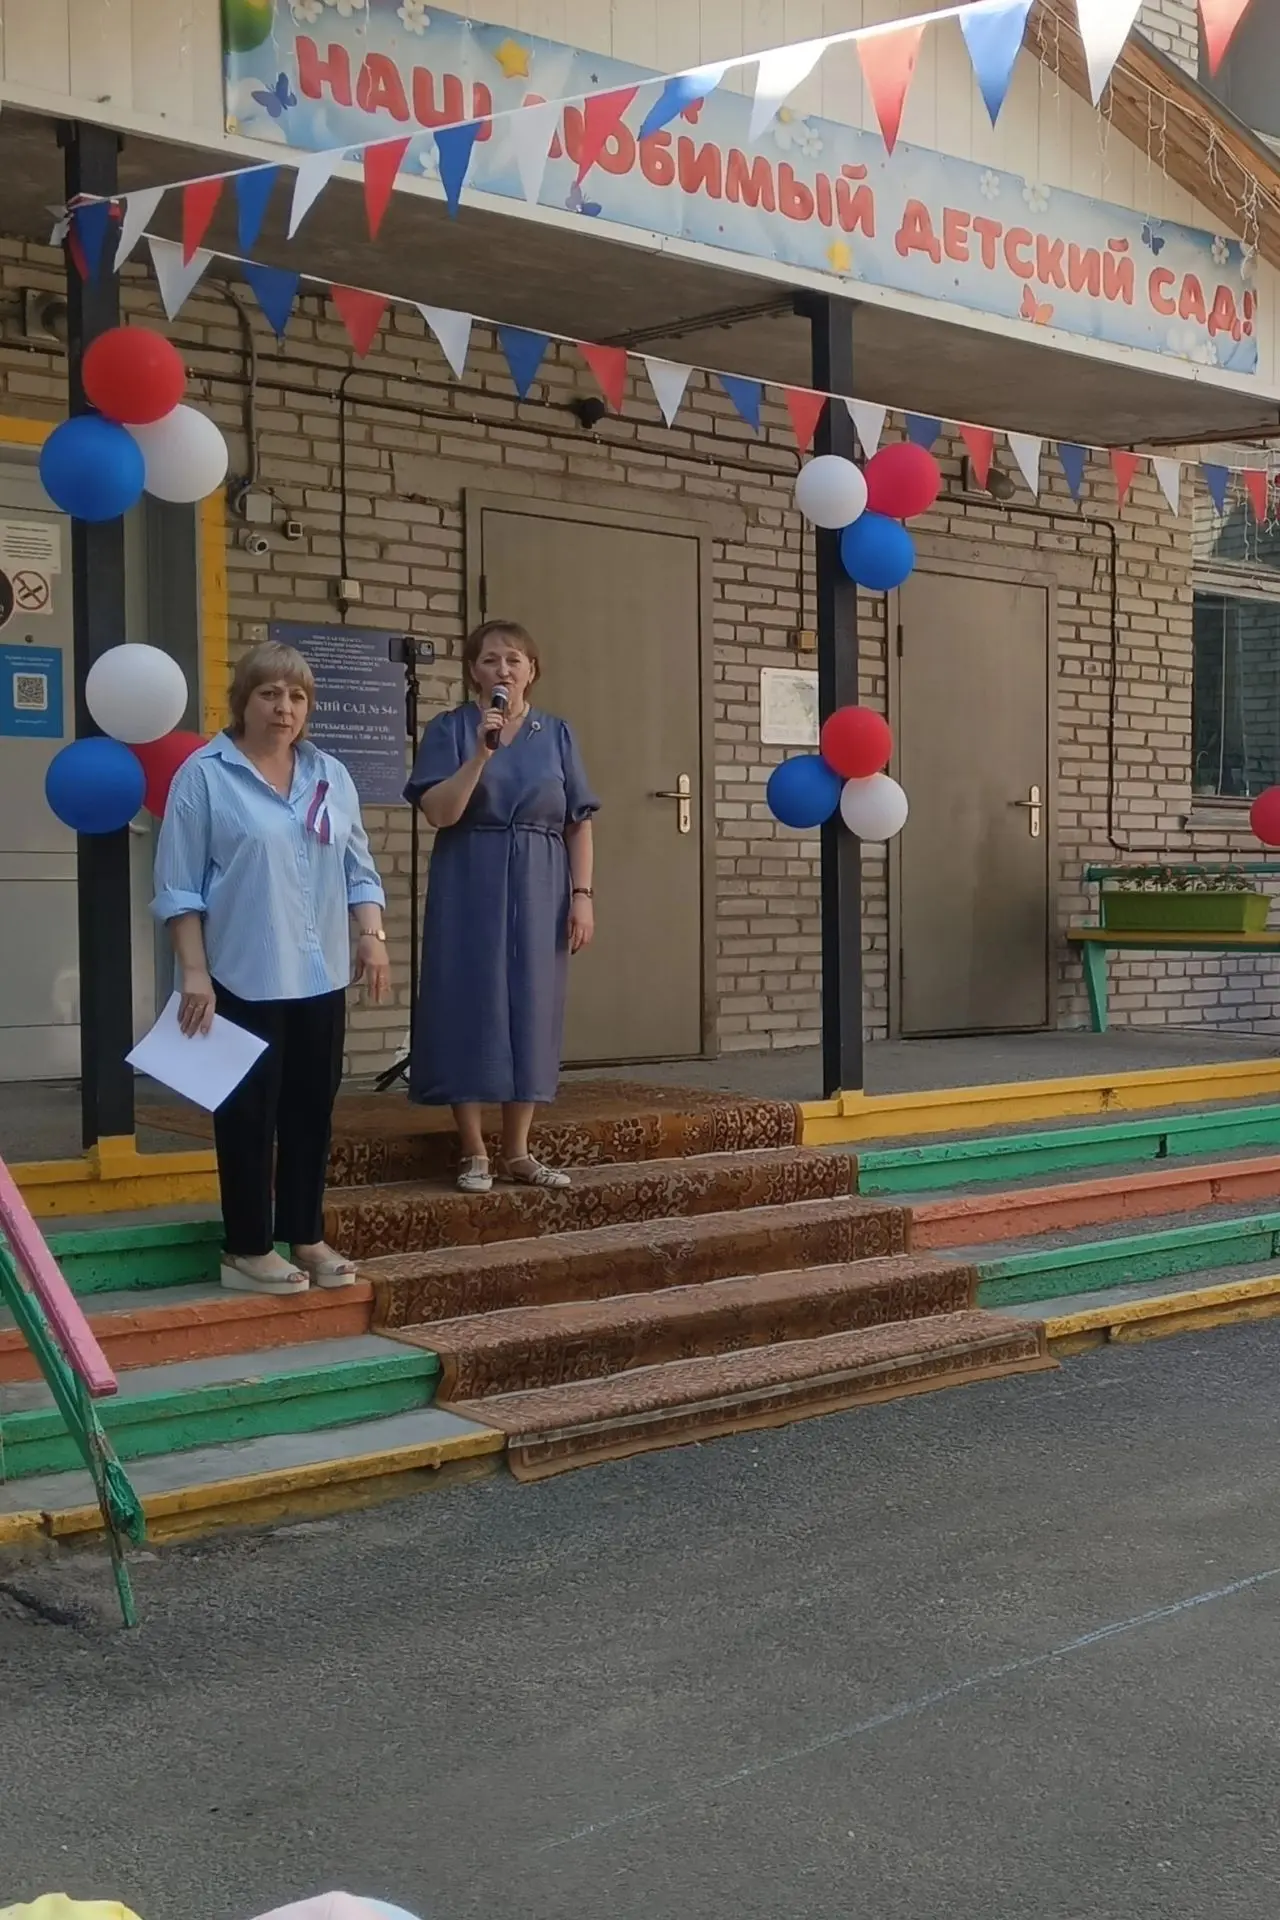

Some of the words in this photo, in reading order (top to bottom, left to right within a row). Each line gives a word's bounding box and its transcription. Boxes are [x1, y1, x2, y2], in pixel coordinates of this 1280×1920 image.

[295, 36, 493, 143] НАШ
[523, 93, 876, 239] ЮБИМЫЙ
[894, 199, 1136, 306] ДЕТСКИЙ
[343, 702, 366, 716] САД
